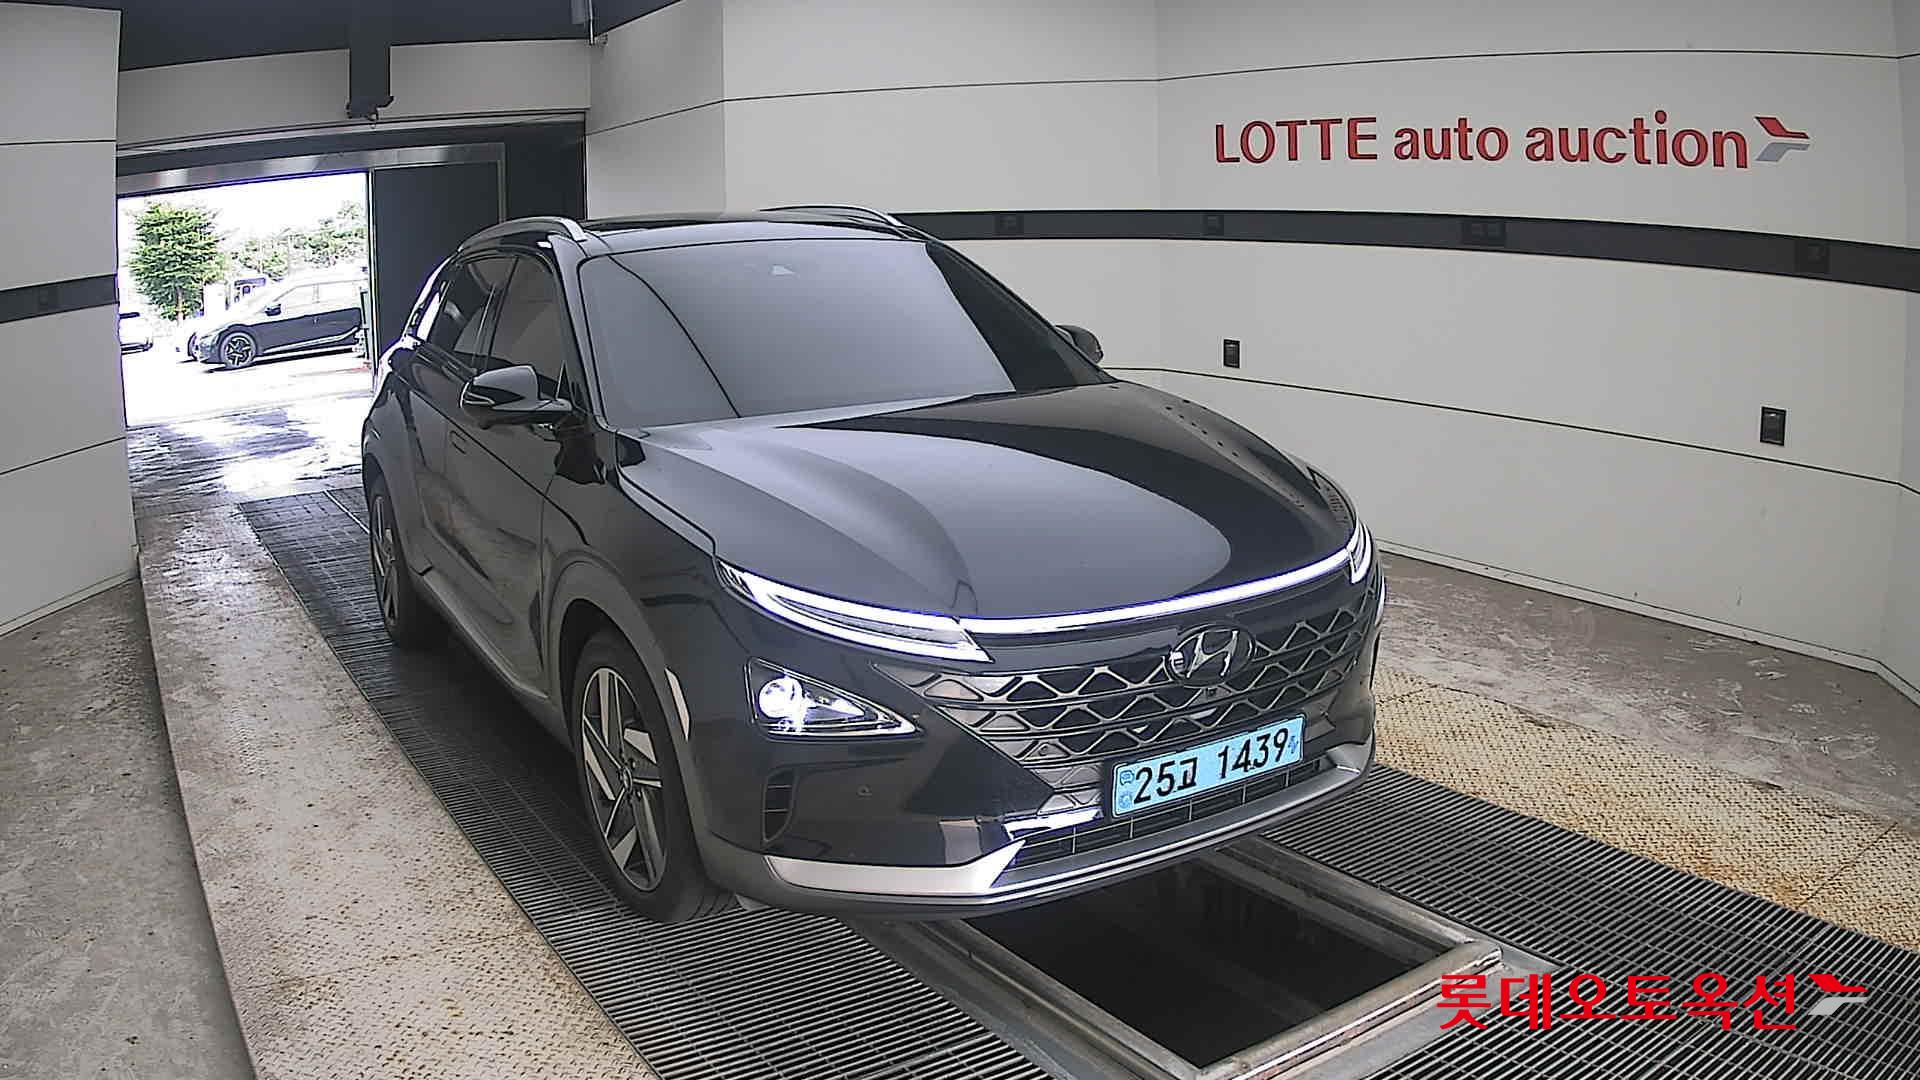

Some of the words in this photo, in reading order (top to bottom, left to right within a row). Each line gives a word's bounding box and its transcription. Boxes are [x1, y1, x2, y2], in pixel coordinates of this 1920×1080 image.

[1215, 116, 1377, 163] LOTTE
[1393, 117, 1509, 162] auto
[1525, 110, 1748, 169] auction
[1133, 757, 1198, 804] 25고
[1217, 728, 1289, 779] 1439
